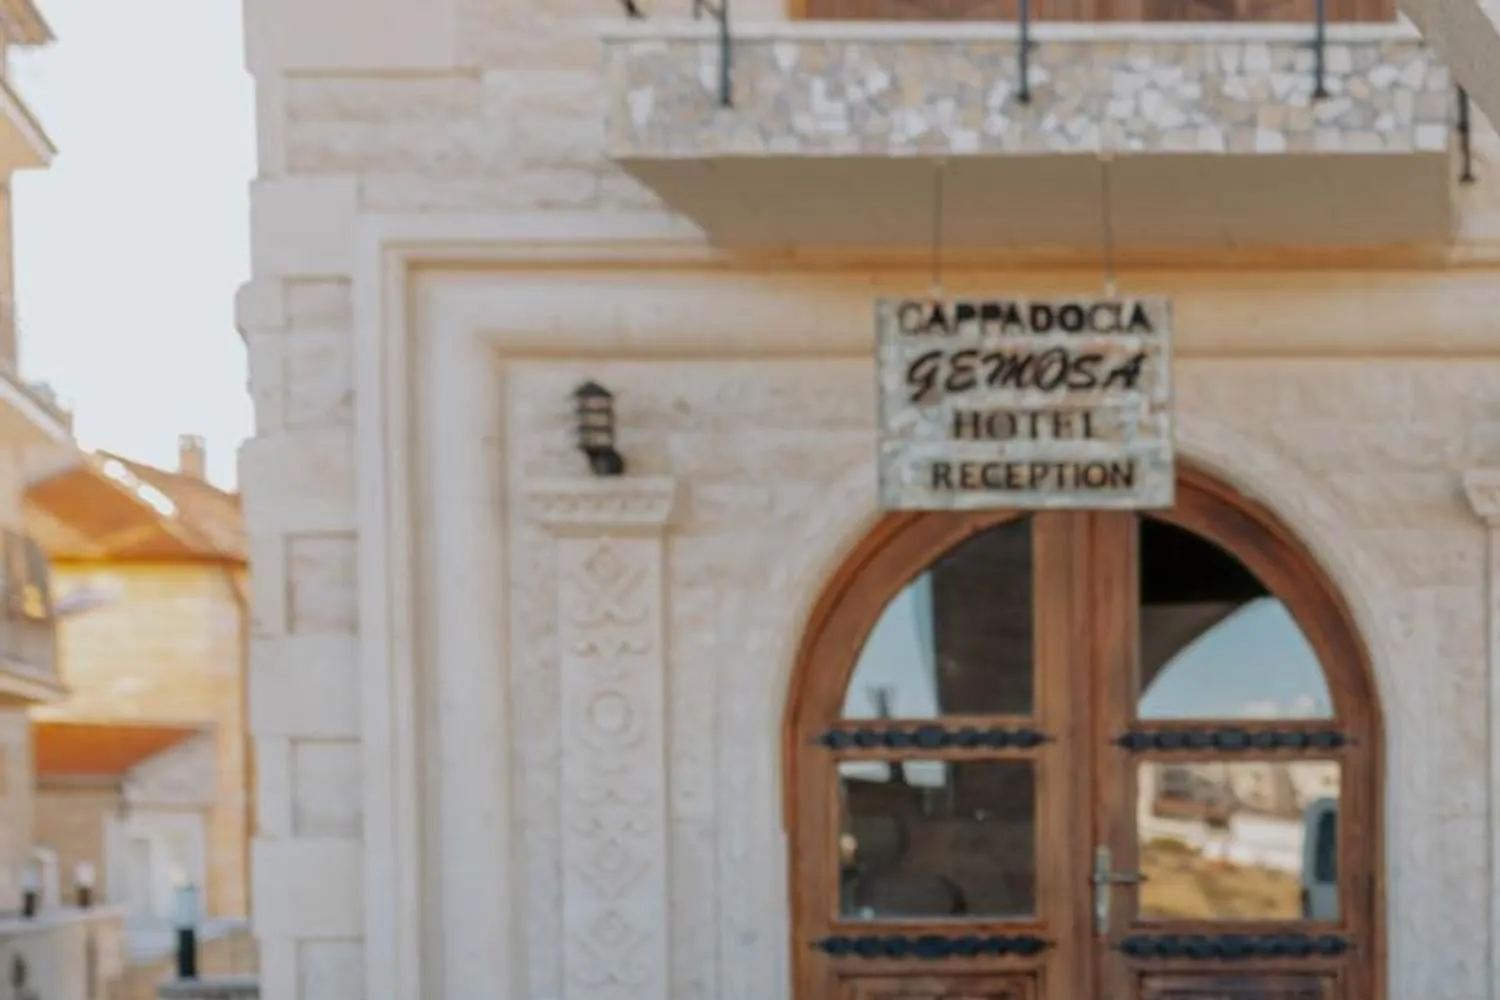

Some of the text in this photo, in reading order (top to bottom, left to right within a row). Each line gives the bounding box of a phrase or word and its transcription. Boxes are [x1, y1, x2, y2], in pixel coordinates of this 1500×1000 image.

[898, 303, 1153, 335] CAPPADOCIA
[905, 346, 1149, 403] GEMOSA
[951, 409, 1106, 440] HOTEL
[931, 460, 1135, 490] RECEPTION
